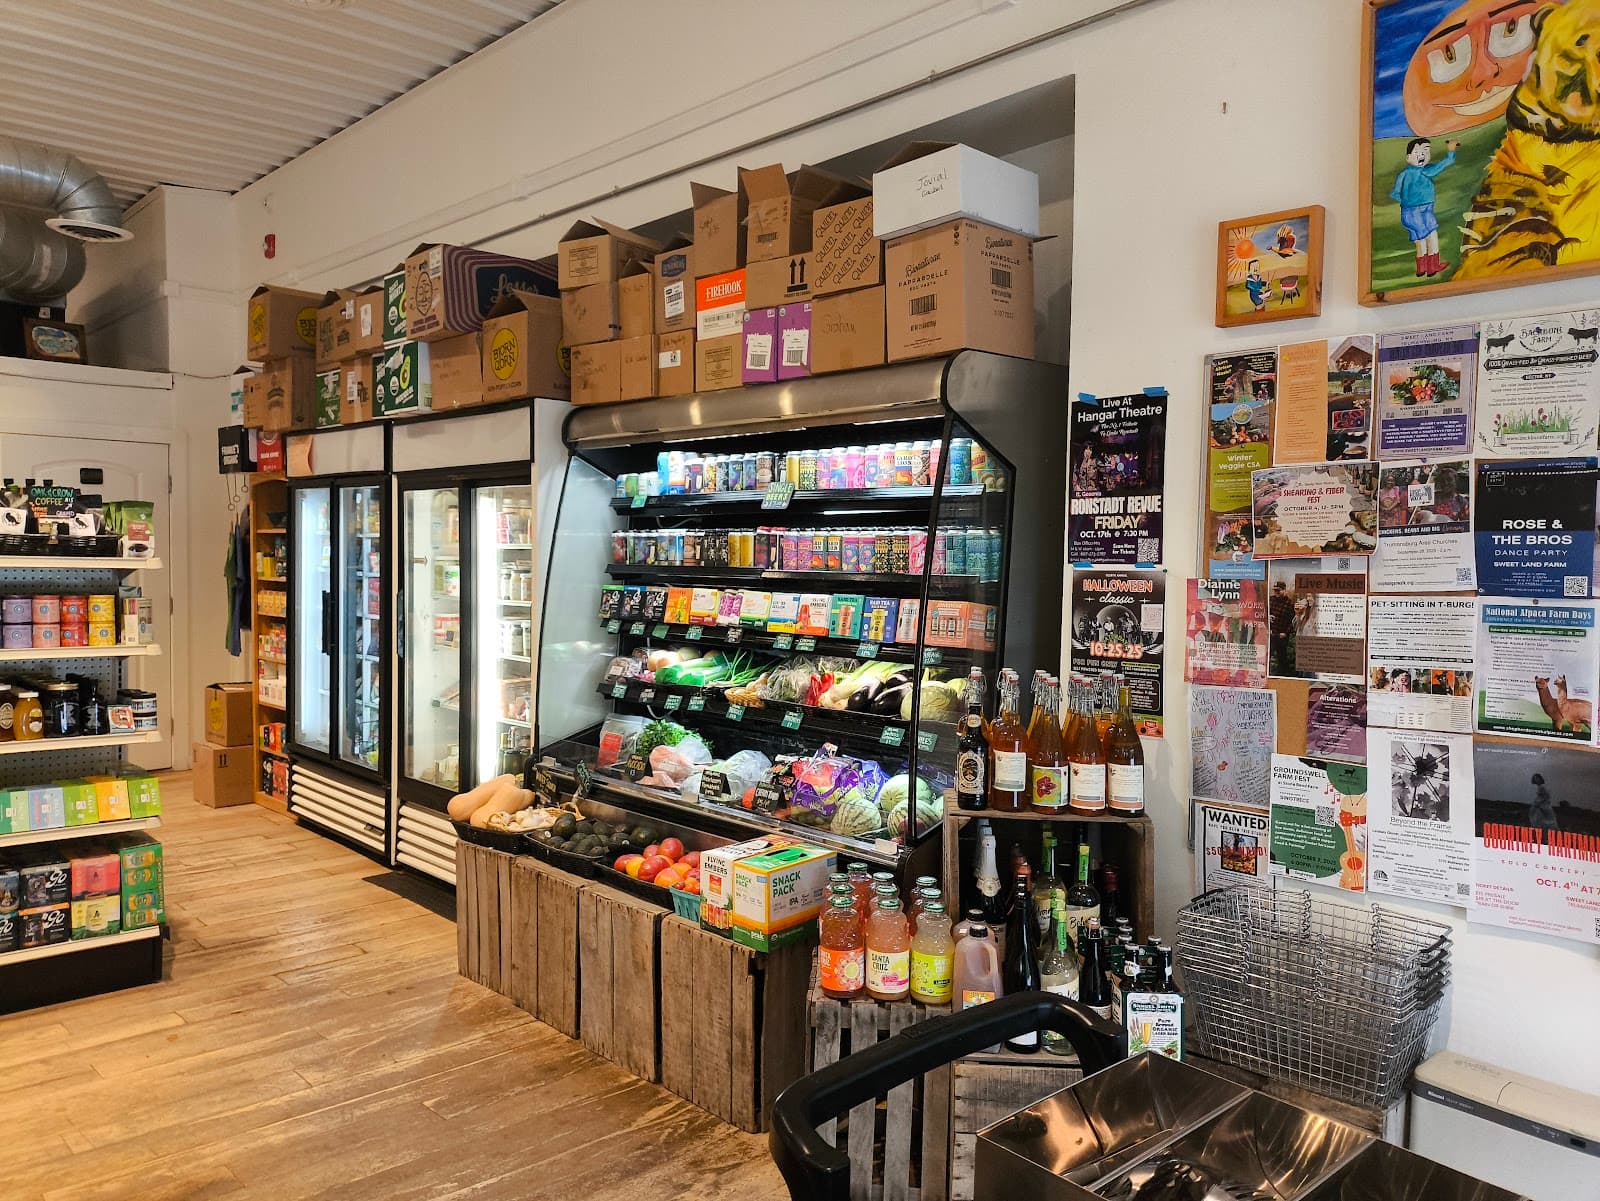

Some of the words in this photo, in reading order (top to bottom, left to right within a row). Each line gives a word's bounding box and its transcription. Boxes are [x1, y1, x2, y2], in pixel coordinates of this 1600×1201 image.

[916, 168, 947, 191] Jovial
[898, 269, 950, 289] PAPPARDELLE
[706, 280, 743, 300] FIREHOOK
[492, 338, 516, 359] BJORN
[494, 355, 516, 371] QORN
[1103, 398, 1121, 409] Live
[1122, 397, 1132, 407] At
[1078, 411, 1117, 424] Hangar
[1118, 405, 1163, 417] Theatre
[1227, 454, 1253, 462] Winter
[1219, 462, 1245, 471] Veggie
[1247, 461, 1261, 469] CSA
[52, 489, 75, 499] CROW
[768, 483, 794, 493] SINGLE
[1283, 488, 1317, 498] SHEARING
[1318, 488, 1325, 496] &
[1325, 486, 1345, 497] FIBER
[35, 497, 64, 507] COFFEE
[765, 492, 789, 501] BEERS
[1307, 496, 1321, 504] FEST
[1071, 497, 1126, 515] RONSTADT
[1127, 495, 1162, 514] REVUE
[1094, 515, 1141, 530] FRIDAY
[1502, 519, 1547, 530] ROSE
[1551, 519, 1563, 530] &
[1080, 531, 1097, 539] OCT.
[1098, 530, 1111, 539] 17th
[1123, 530, 1138, 538] 7:30
[1138, 529, 1149, 537] PM
[1492, 535, 1521, 545] THE
[1526, 535, 1573, 545] BROS
[1083, 578, 1153, 593] HALLOWEEN
[1198, 578, 1241, 590] Dianne
[1299, 578, 1322, 589] Live
[1326, 578, 1364, 590] Music
[1099, 592, 1135, 605] classic
[1211, 590, 1241, 604] Lynn
[1438, 601, 1474, 609] T-BURG!
[1486, 607, 1518, 616] National
[1520, 608, 1547, 619] Alpaca
[1549, 608, 1571, 618] Farm
[1572, 610, 1592, 621] Days
[1089, 640, 1144, 660] 10.25.25
[1320, 694, 1357, 704] Alterations
[1273, 766, 1327, 779] GROUNDSWELL
[1273, 773, 1293, 781] FARM
[1294, 775, 1311, 783] FEST
[1390, 816, 1416, 828] Beyond
[1416, 819, 1428, 827] the
[1483, 822, 1543, 855] COURTNEY
[707, 856, 726, 867] FLYING
[705, 862, 728, 876] EMBERS
[1501, 859, 1528, 868] SOLO
[1535, 863, 1586, 877] CONCERT
[736, 873, 753, 884] SNACK
[772, 870, 801, 888] SNACK
[773, 884, 796, 899] PACK
[1536, 878, 1561, 891] OCT.
[1580, 885, 1594, 897] AT
[789, 898, 799, 906] IPA
[871, 953, 890, 964] SANTA
[872, 962, 889, 972] CRUZ
